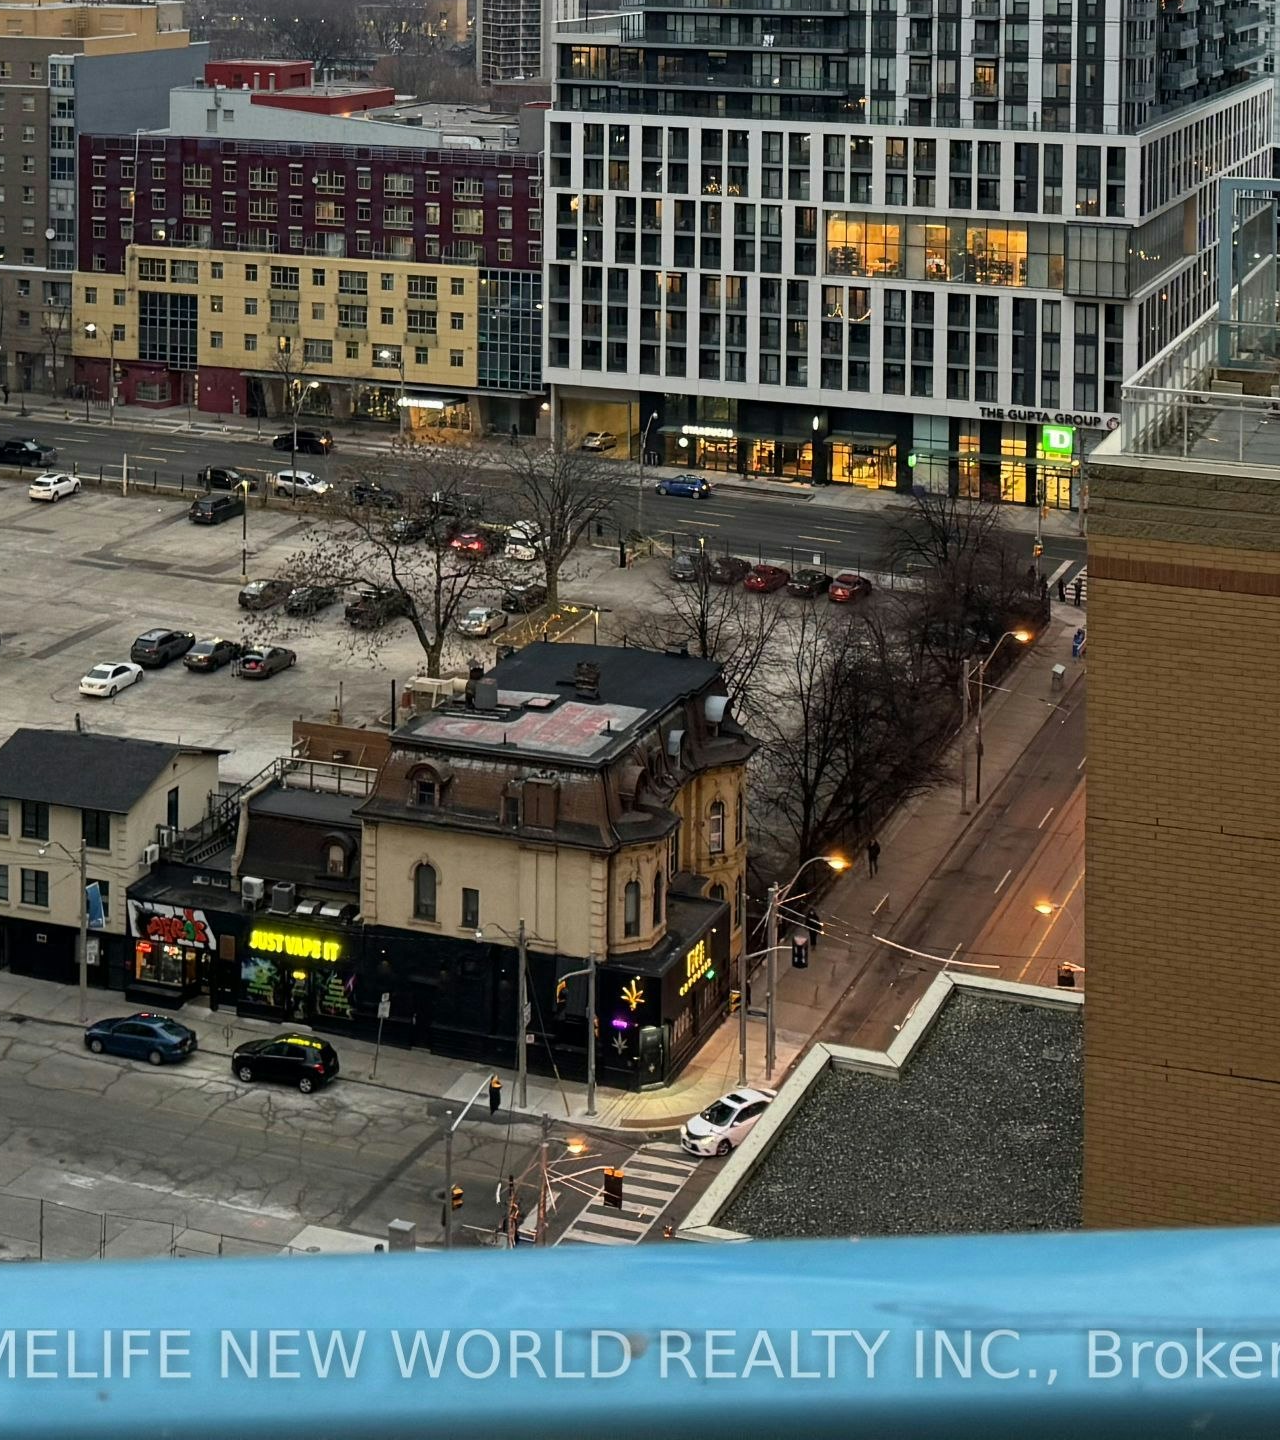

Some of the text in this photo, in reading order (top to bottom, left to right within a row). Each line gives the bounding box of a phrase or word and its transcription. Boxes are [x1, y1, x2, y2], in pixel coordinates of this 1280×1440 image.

[979, 406, 1101, 427] THE GUPTA GROUP
[1046, 429, 1070, 448] TD
[249, 930, 339, 962] JUST VAPE IT
